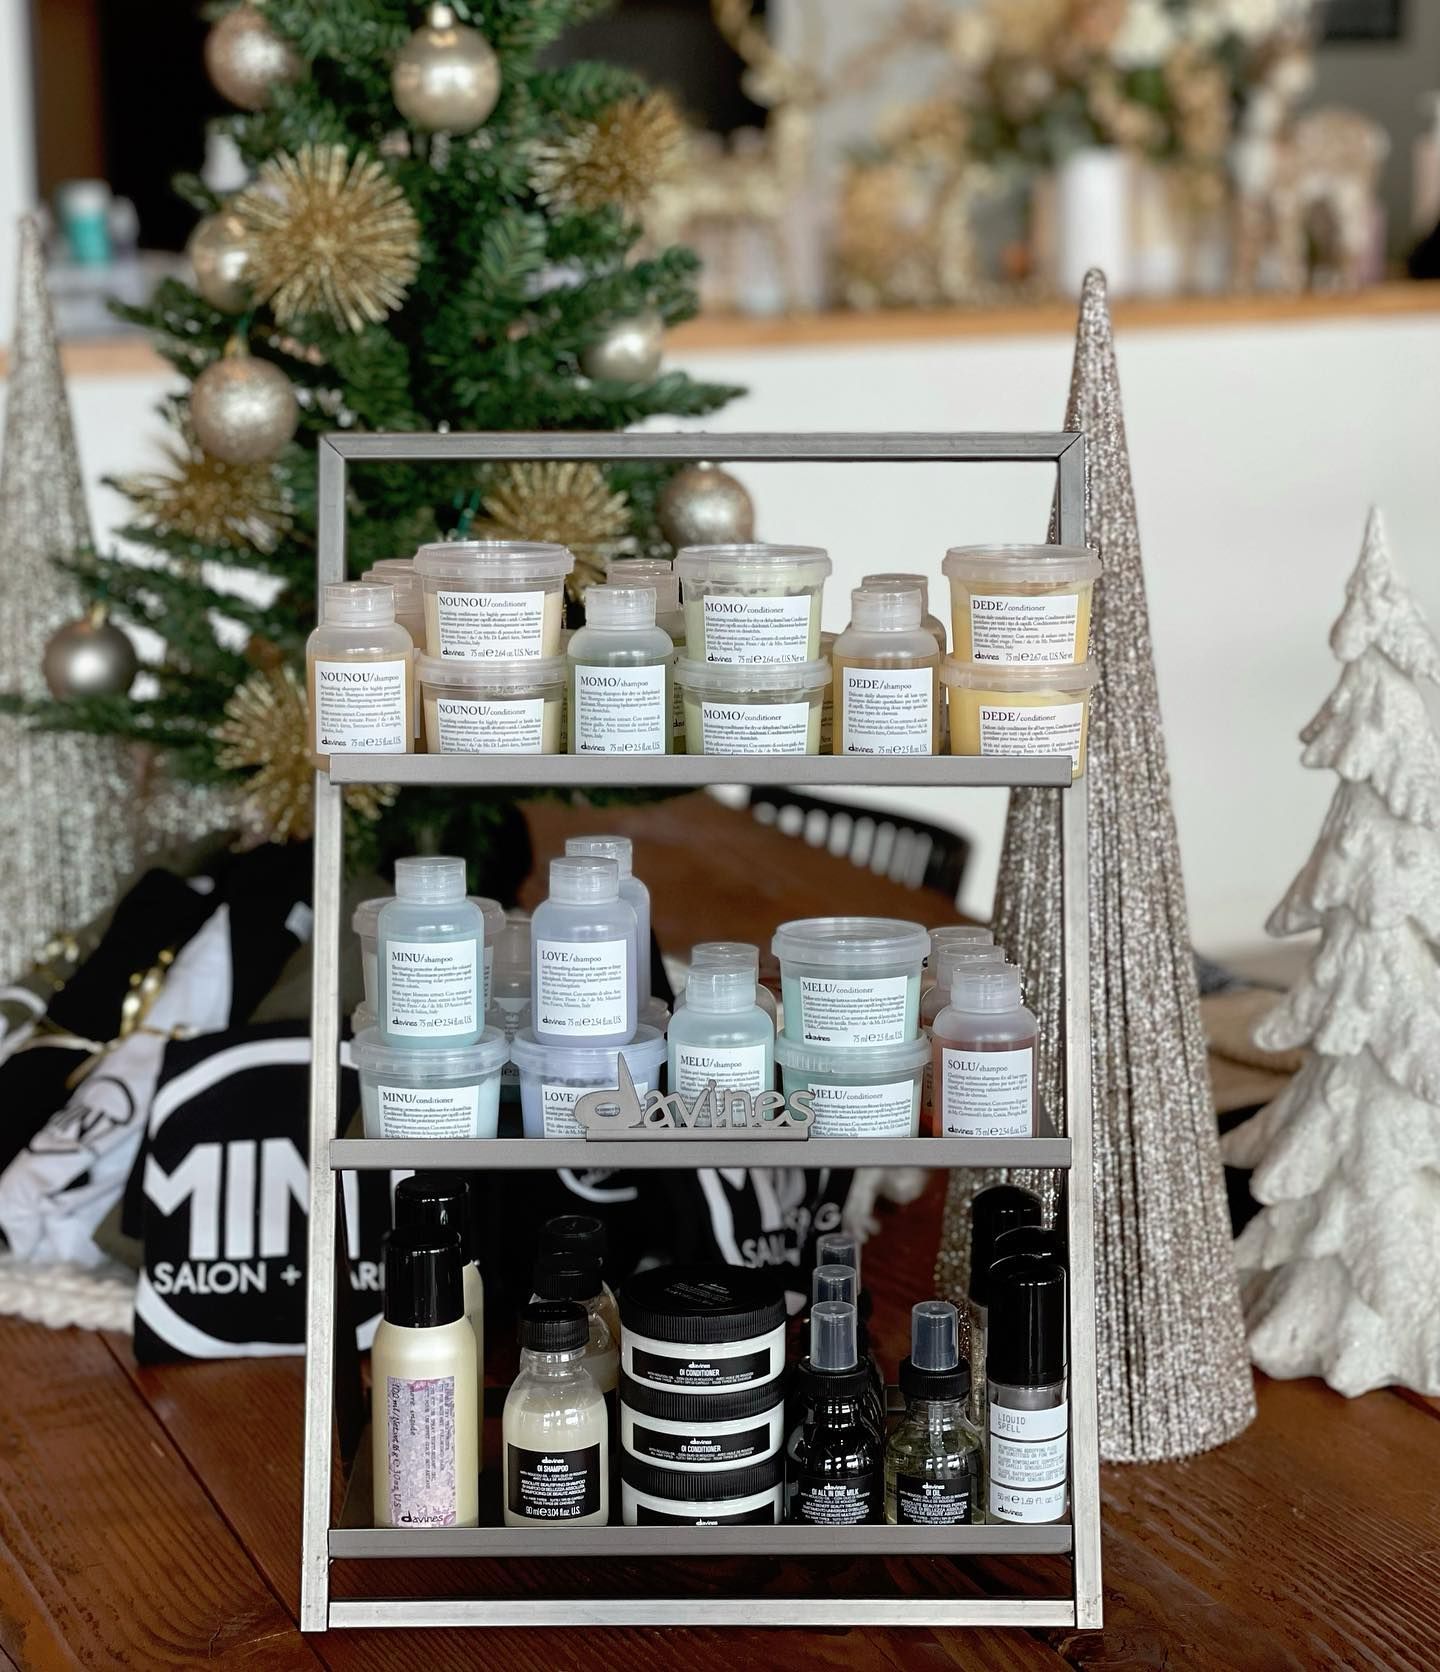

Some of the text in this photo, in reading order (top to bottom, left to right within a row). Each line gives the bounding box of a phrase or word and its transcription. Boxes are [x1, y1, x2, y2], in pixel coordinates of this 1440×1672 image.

[705, 602, 784, 614] MOMO/conditioner
[972, 600, 1046, 611] DEDE/conditioner
[470, 649, 478, 657] 75
[478, 649, 485, 657] ml
[707, 652, 732, 663] davines
[738, 655, 745, 663] 75
[745, 655, 753, 663] ml
[974, 651, 1000, 660] davines
[1005, 653, 1012, 661] 75
[1012, 653, 1020, 661] ml
[320, 671, 400, 683] NOUNOU/shampoo
[580, 676, 648, 688] MOMO/shampoo
[848, 678, 912, 691] DEDE/shampoo
[438, 703, 527, 716] NOUNOU/conditioner
[703, 709, 782, 721] MOMO/conditioner
[982, 711, 1056, 722] DEDE/conditioner
[321, 735, 347, 747] davines
[351, 738, 358, 747] 75
[358, 738, 365, 747] ml
[580, 740, 605, 752] davines
[610, 744, 616, 752] 75
[617, 744, 625, 752] ml
[848, 741, 874, 753] davines
[878, 745, 885, 754] 75
[392, 951, 453, 964] MINU/shampoo
[802, 981, 873, 993] MELU/conditioner
[392, 1016, 418, 1027] davines
[419, 1019, 426, 1027] 75
[427, 1019, 433, 1027] ml
[542, 1016, 566, 1026] davines
[567, 1018, 574, 1026] 75
[574, 1018, 581, 1026] ml
[853, 1034, 860, 1043] 75
[680, 1055, 742, 1069] MELU/shampoo
[948, 1059, 1008, 1073] SOLU/shampoo
[574, 1052, 816, 1129] davines
[383, 1092, 454, 1104] MINU/conditioner
[544, 1091, 579, 1103] LOVE/
[948, 1124, 974, 1135] davines
[975, 1127, 981, 1136] 75
[982, 1127, 989, 1136] ml
[153, 1260, 267, 1294] SALON
[686, 1369, 720, 1377] CONDITIONER
[997, 1413, 1026, 1426] LIQUID
[997, 1421, 1021, 1434] SPELL
[687, 1445, 722, 1453] CONDITIONER
[543, 1464, 569, 1472] SHAMPOO
[846, 1488, 859, 1496] MILK
[401, 1510, 444, 1523] davines
[547, 1508, 559, 1517] 3.04
[998, 1505, 1023, 1517] davines
